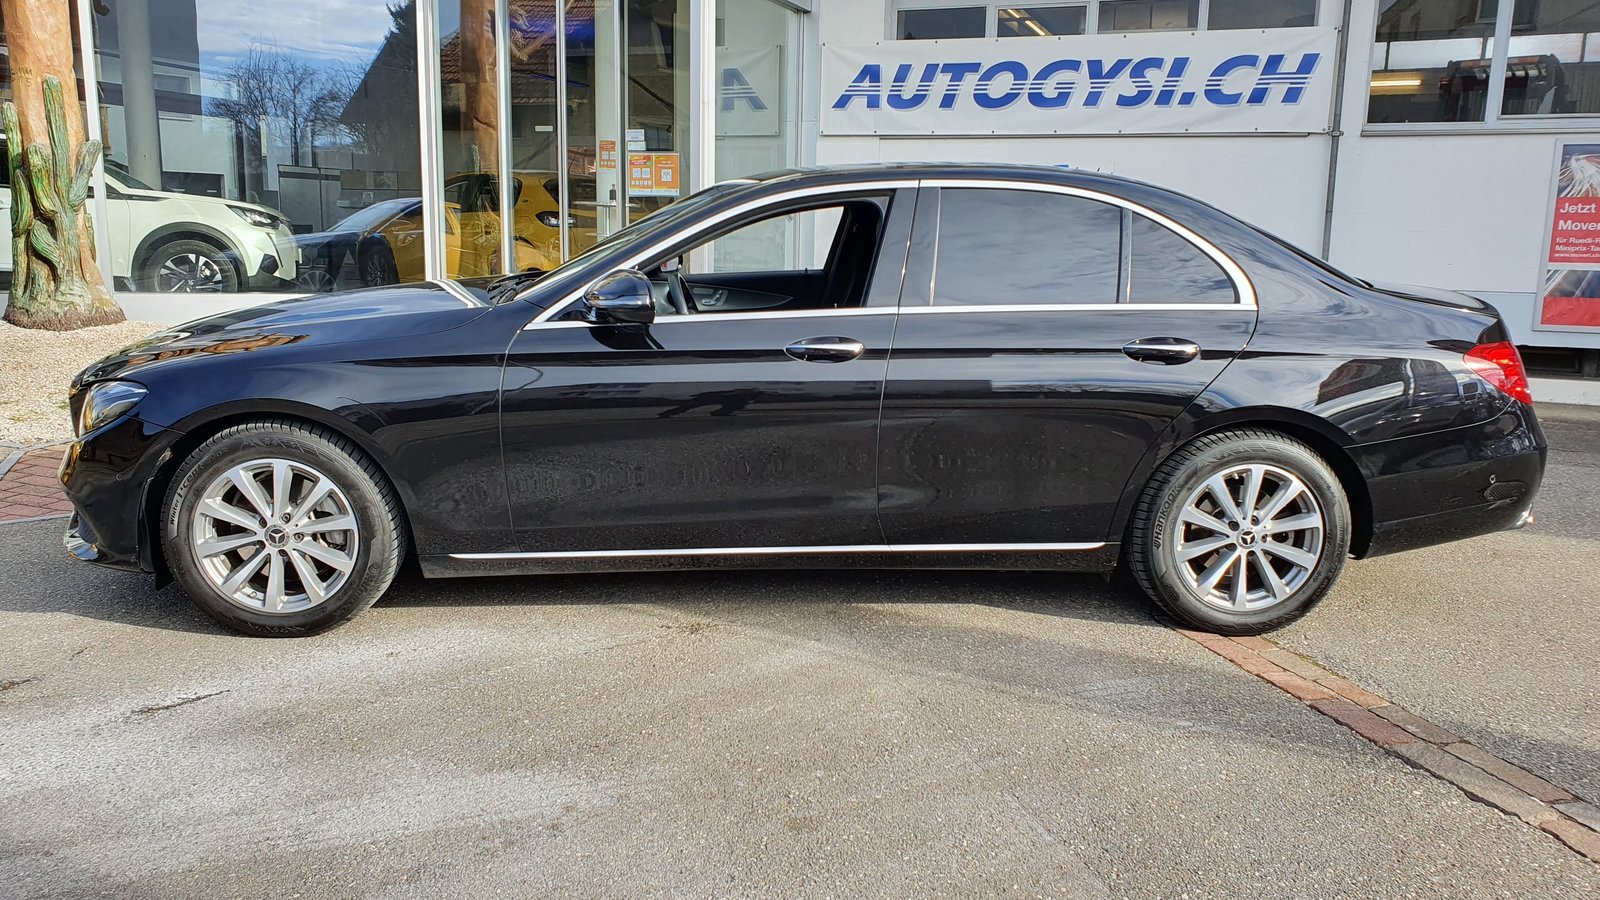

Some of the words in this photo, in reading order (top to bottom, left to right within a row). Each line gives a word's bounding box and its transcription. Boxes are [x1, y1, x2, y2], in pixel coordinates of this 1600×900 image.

[831, 52, 1321, 111] AUTOGYSI.CH
[1560, 202, 1596, 214] Jetzt
[1556, 236, 1568, 244] für
